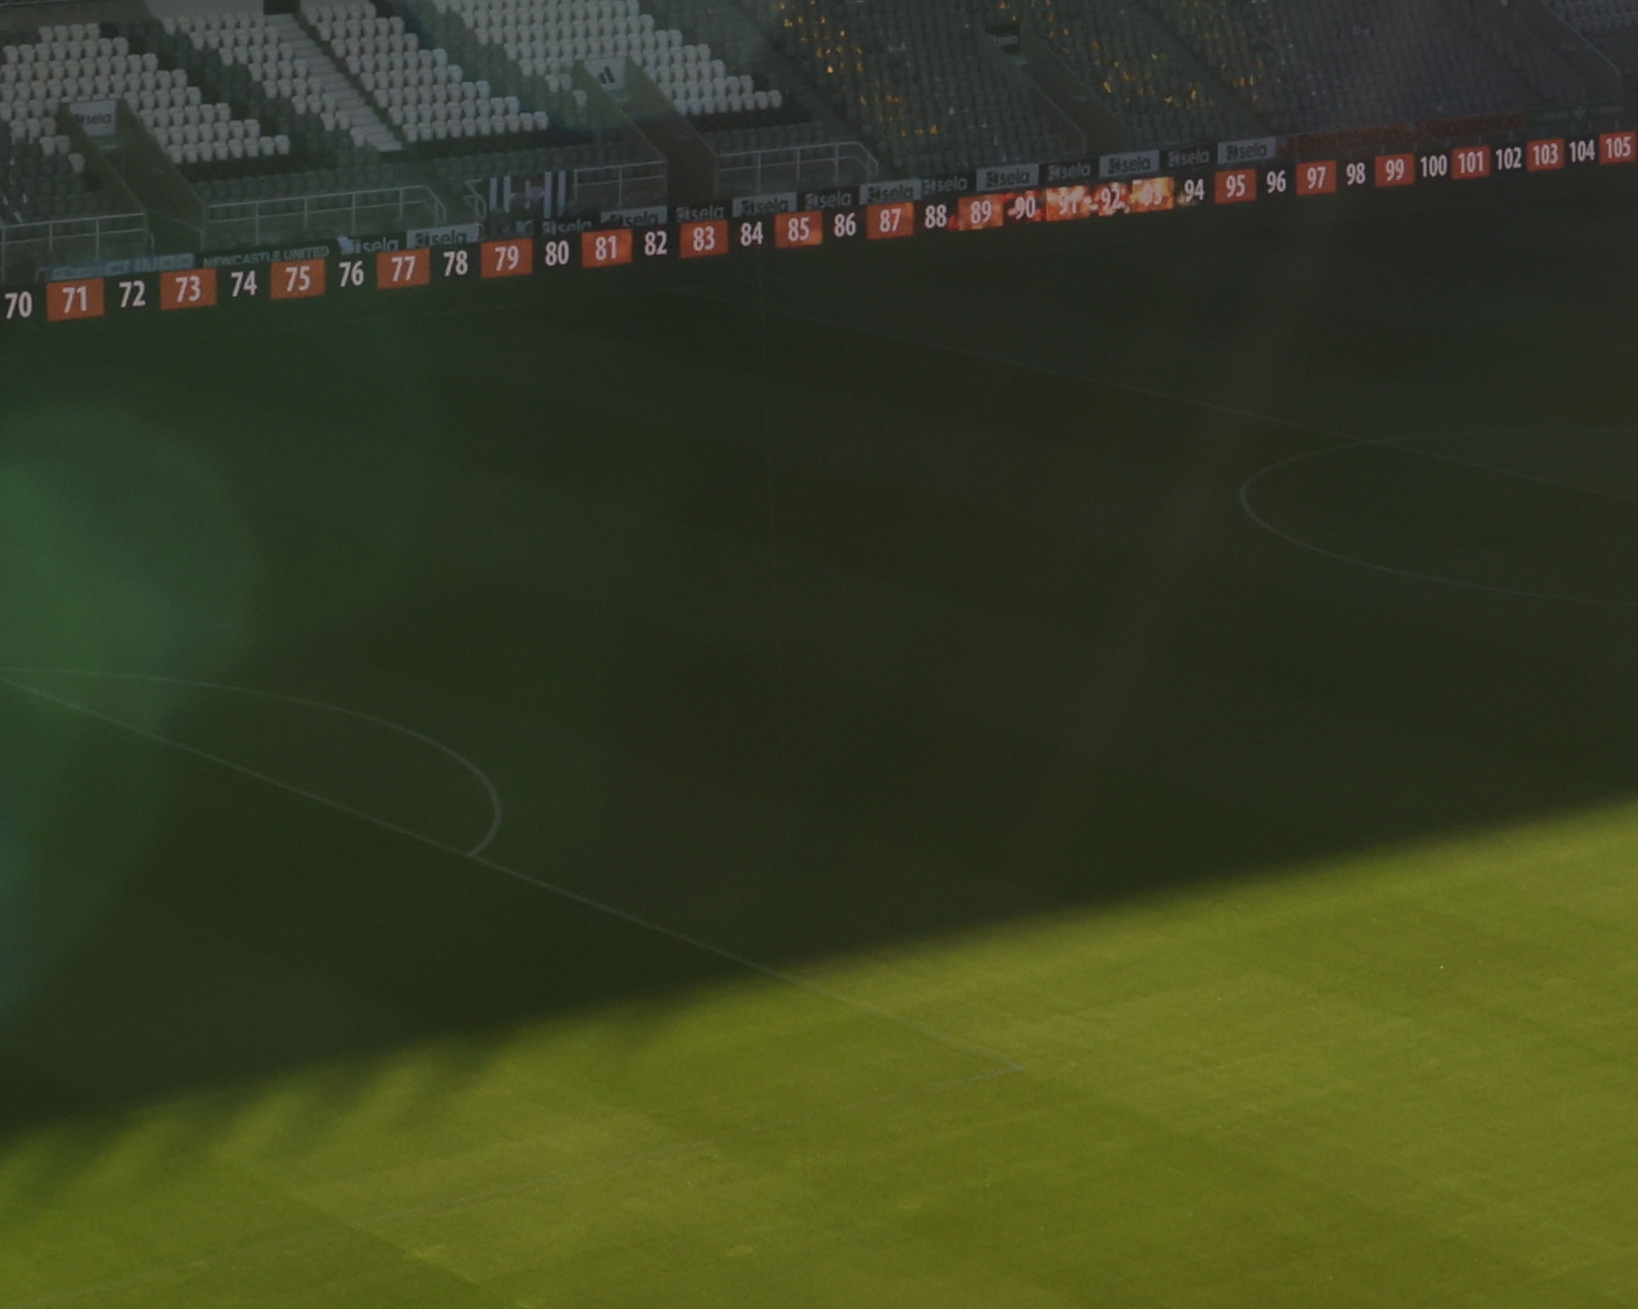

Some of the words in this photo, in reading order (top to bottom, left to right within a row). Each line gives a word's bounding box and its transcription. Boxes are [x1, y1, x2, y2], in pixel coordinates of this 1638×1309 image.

[86, 112, 112, 125] sela
[1181, 150, 1210, 164] sela
[1239, 144, 1267, 158] sela
[1060, 163, 1091, 178] sela
[1121, 156, 1150, 170] sela
[938, 177, 967, 192] sela
[999, 170, 1030, 185] sela
[821, 190, 851, 207] sela
[881, 186, 913, 200] sela
[692, 206, 724, 220] sela
[755, 198, 788, 213] sela
[5, 292, 32, 318] 70
[63, 286, 87, 313] 71
[120, 281, 145, 307] 72
[176, 275, 200, 302] 73
[231, 271, 257, 296] 74
[286, 266, 310, 291] 75
[339, 261, 363, 286] 76
[392, 256, 415, 281] 77
[444, 250, 468, 276] 78
[495, 246, 519, 270] 79
[546, 241, 569, 266] 80
[595, 236, 616, 260] 81
[645, 231, 667, 255] 82
[693, 226, 715, 251] 83
[741, 222, 763, 246] 84
[788, 217, 810, 241] 85
[835, 213, 856, 237] 86
[880, 208, 901, 232] 87
[925, 204, 947, 228] 88
[971, 200, 993, 223] 89
[1013, 196, 1035, 219] 90
[1181, 179, 1204, 202] 94
[1226, 175, 1245, 197] 95
[1267, 171, 1286, 193] 96
[1307, 166, 1326, 189] 97
[1347, 163, 1365, 185] 98
[1386, 159, 1404, 181] 99
[1421, 155, 1447, 177] 100
[1459, 151, 1483, 173] 101
[1496, 147, 1521, 169] 102
[1533, 143, 1558, 165] 103
[1570, 140, 1595, 162] 104
[1606, 136, 1631, 158] 105
[429, 229, 467, 244] sela
[203, 251, 281, 268] NEWCASTLE
[283, 245, 329, 261] UNITED
